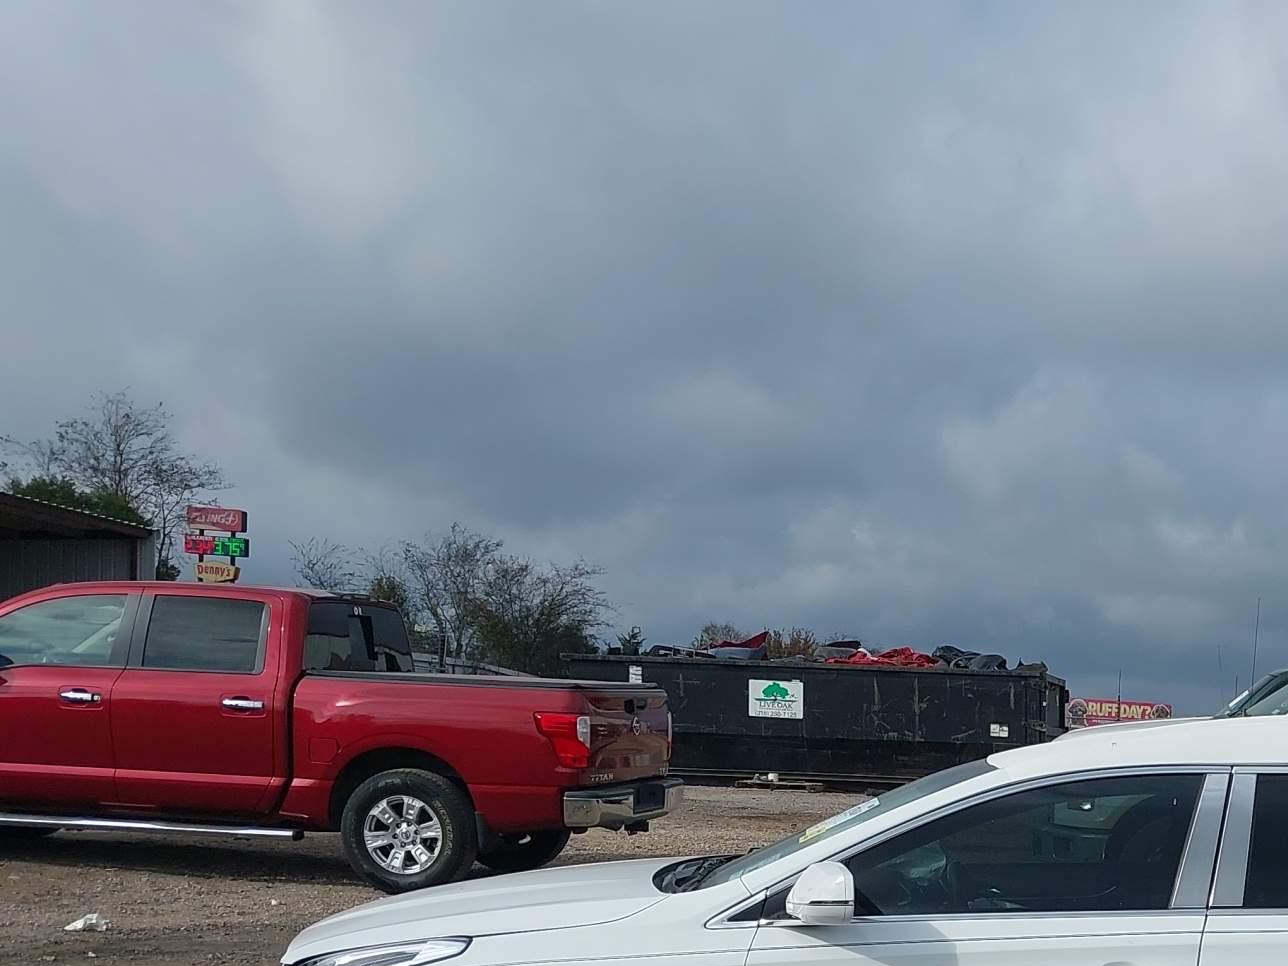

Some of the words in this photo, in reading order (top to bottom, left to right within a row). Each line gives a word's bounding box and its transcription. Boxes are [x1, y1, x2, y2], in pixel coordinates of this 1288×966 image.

[759, 701, 776, 709] LIVE
[777, 702, 793, 710] OAK
[1087, 702, 1119, 717] RUFF
[1120, 703, 1152, 719] DAY?
